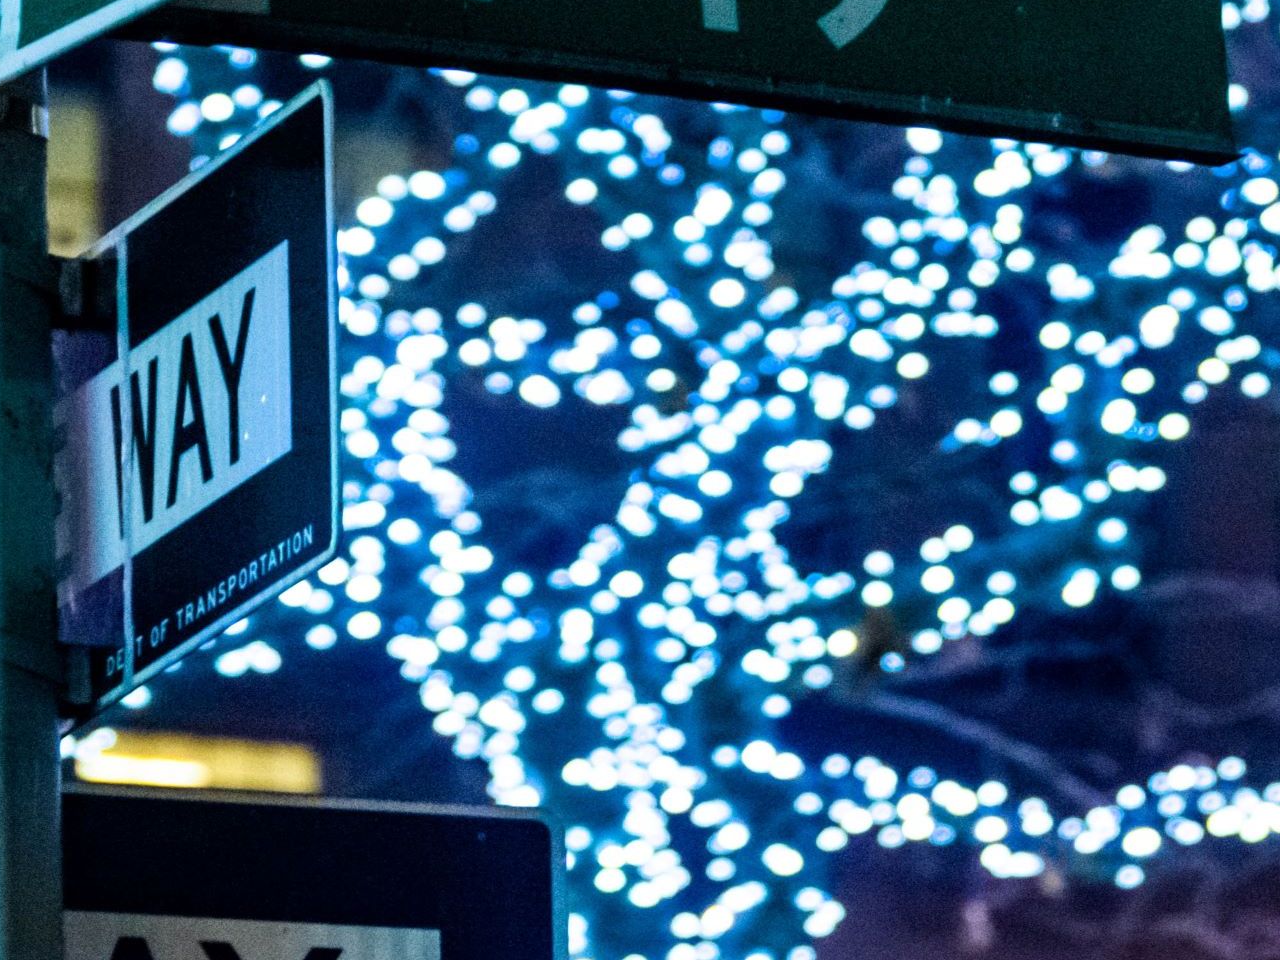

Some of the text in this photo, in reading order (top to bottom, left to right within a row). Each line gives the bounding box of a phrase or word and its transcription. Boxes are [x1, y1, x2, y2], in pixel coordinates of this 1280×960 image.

[110, 288, 256, 539] WAY
[106, 524, 314, 677] DET OF TRANSPORTATION
